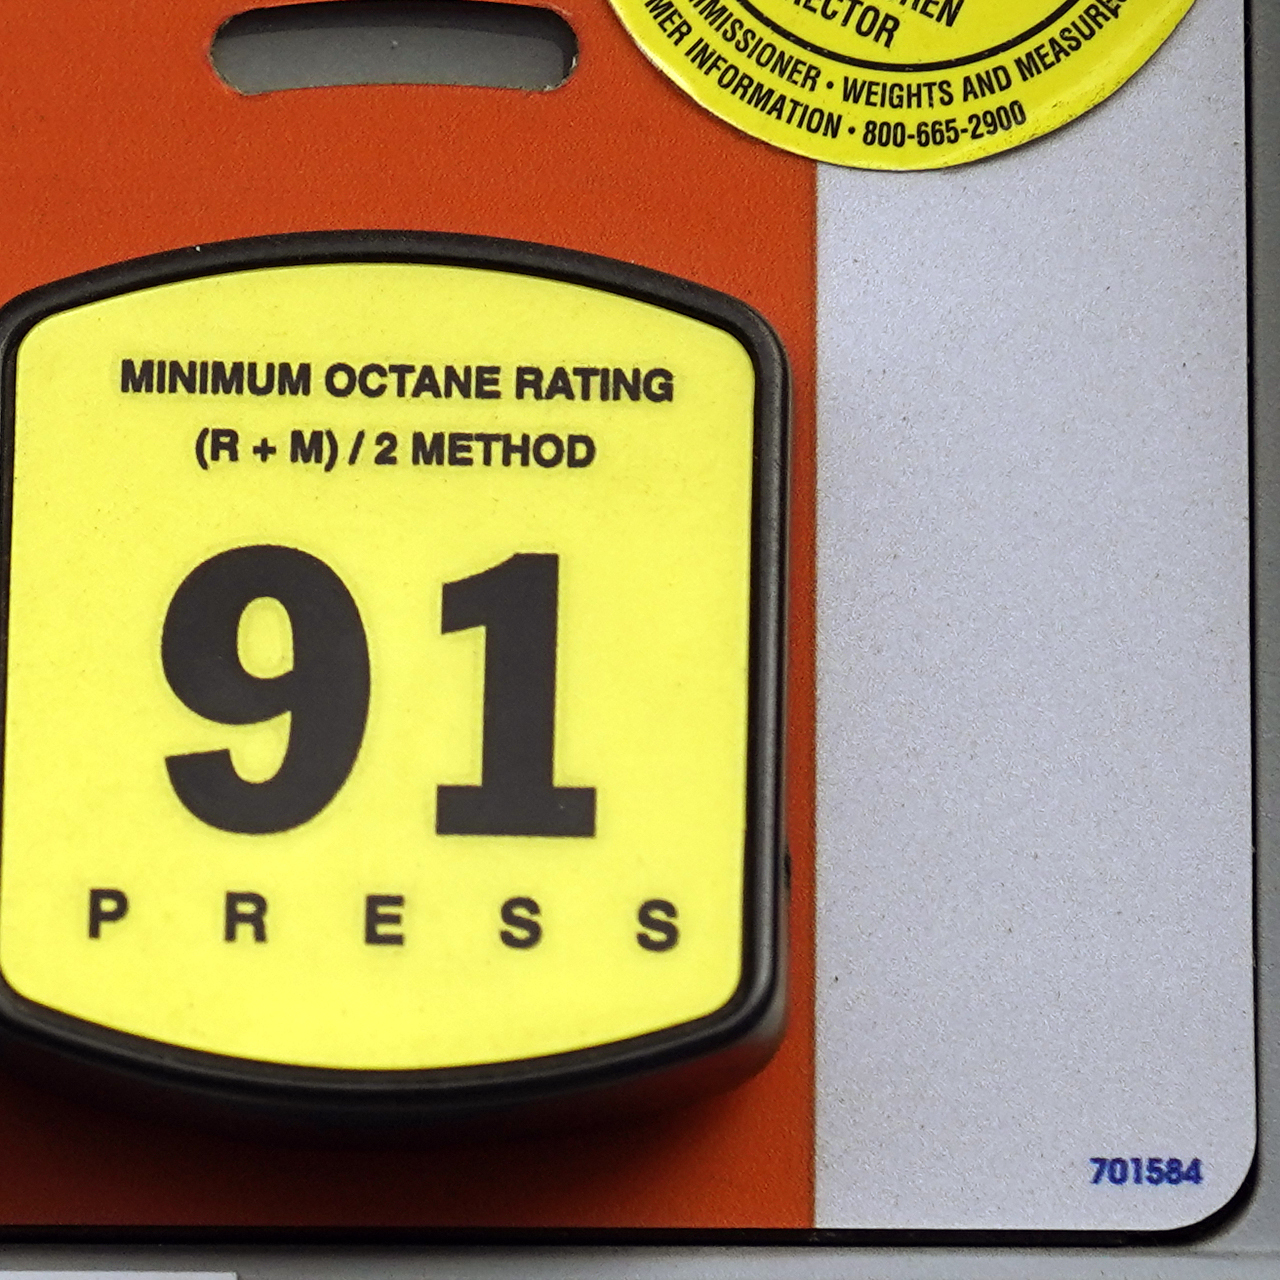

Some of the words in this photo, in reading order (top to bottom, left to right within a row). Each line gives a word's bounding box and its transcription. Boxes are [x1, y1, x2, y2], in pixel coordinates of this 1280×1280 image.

[688, 39, 843, 139] INFORMATION
[861, 99, 1027, 150] 800-665-2900
[842, 74, 956, 109] WEIGHTS
[961, 63, 1014, 102] AND
[120, 361, 311, 397] MINIMUM
[327, 363, 503, 399] OCTANE
[515, 365, 675, 403] RATING
[195, 430, 241, 469] (R
[290, 430, 339, 469] M)
[375, 432, 397, 465] 2
[411, 432, 597, 469] METHOD
[161, 543, 598, 839] 91
[1089, 1157, 1204, 1186] 701584
